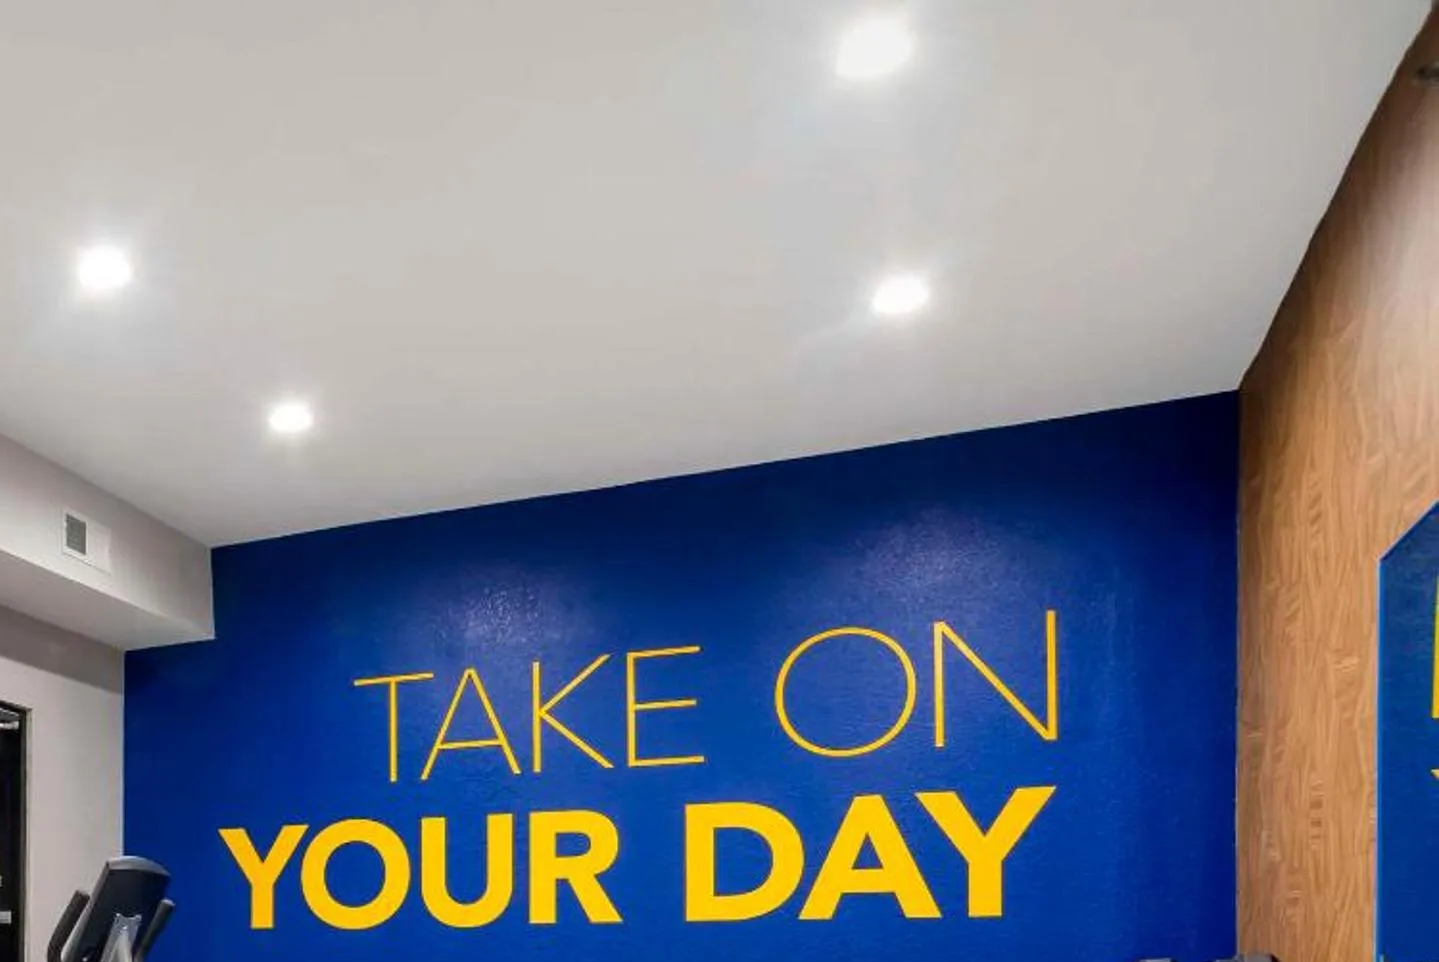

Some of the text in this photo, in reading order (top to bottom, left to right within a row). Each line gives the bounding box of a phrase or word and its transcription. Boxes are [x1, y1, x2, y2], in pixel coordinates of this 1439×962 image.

[355, 610, 1058, 783] TAKE ON
[219, 785, 1056, 930] YOUR DAY
